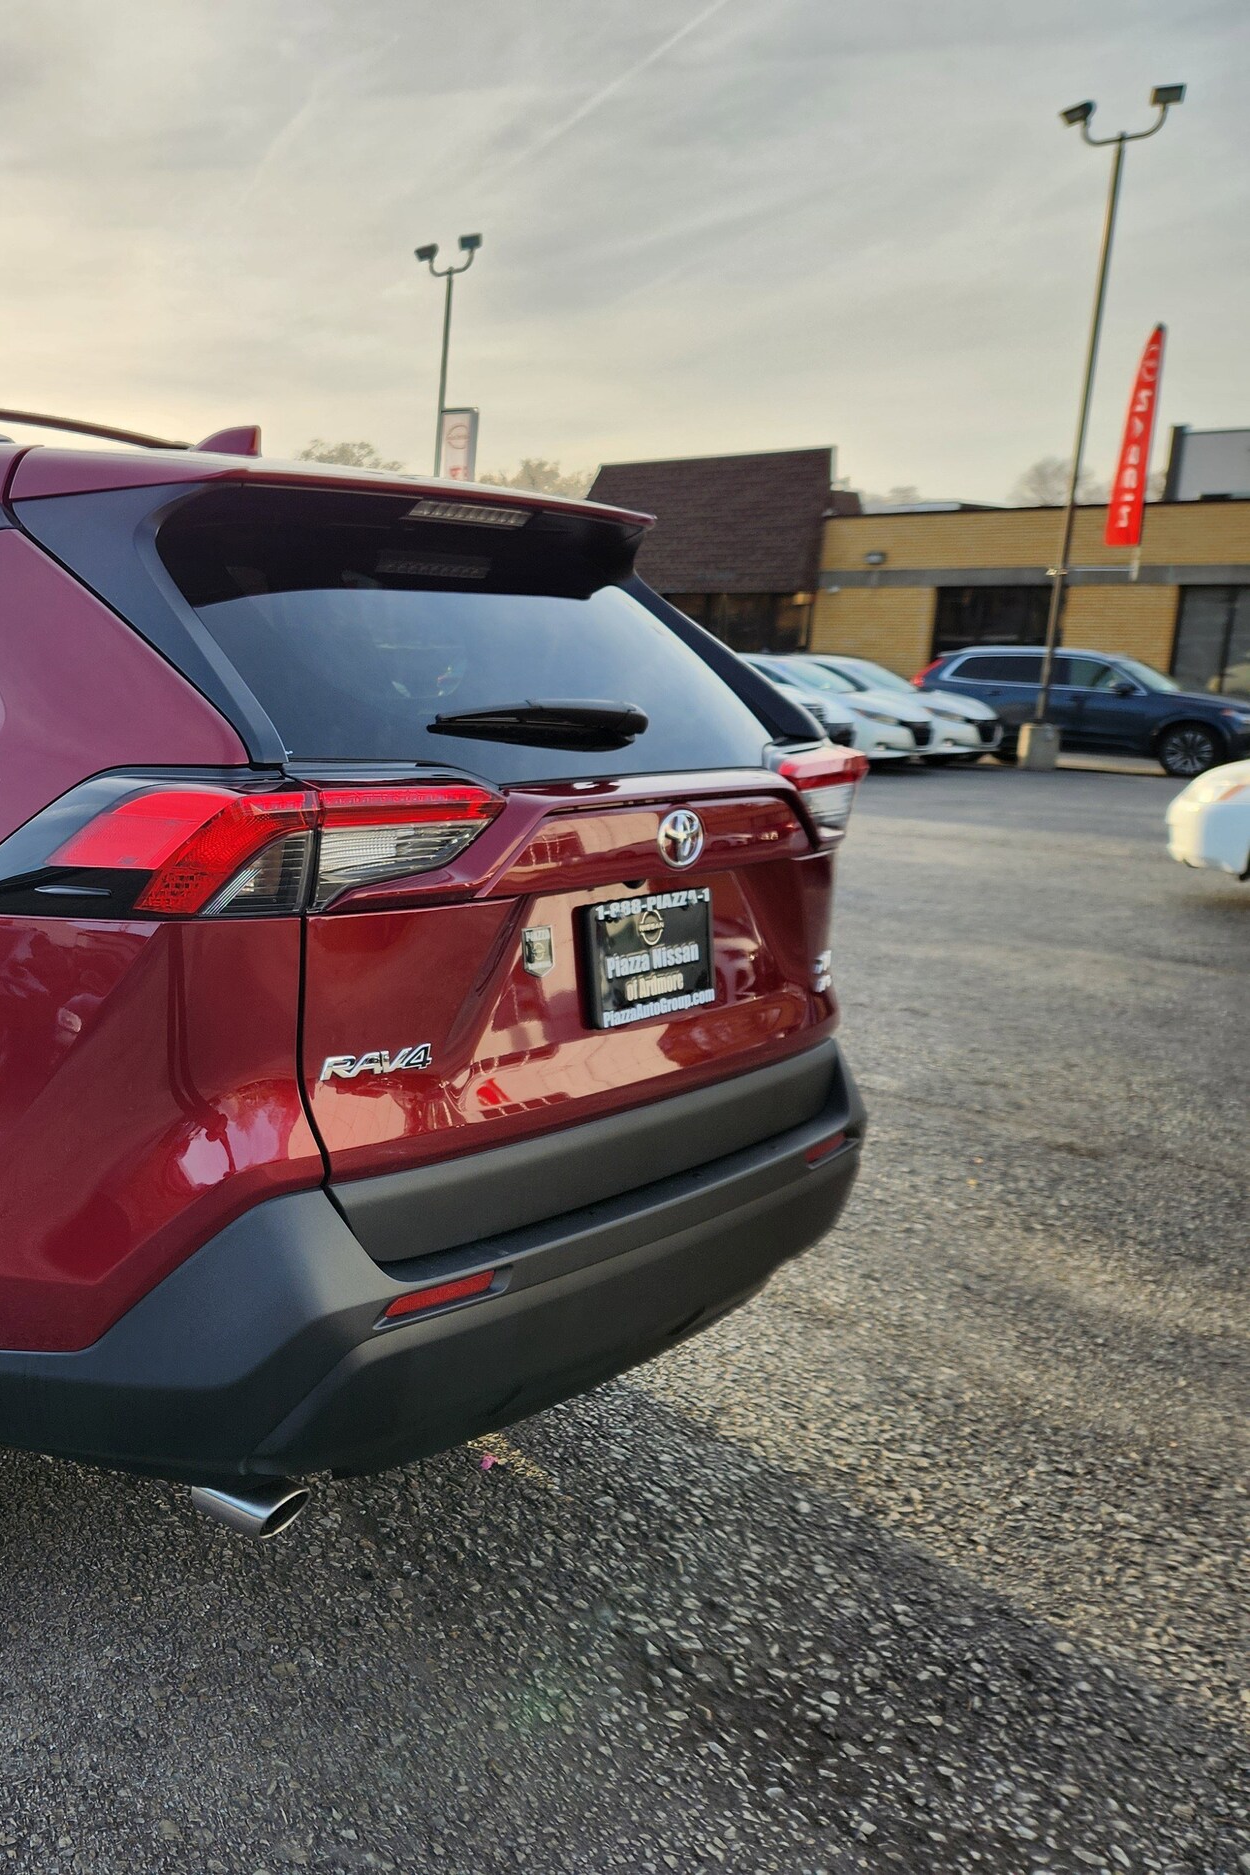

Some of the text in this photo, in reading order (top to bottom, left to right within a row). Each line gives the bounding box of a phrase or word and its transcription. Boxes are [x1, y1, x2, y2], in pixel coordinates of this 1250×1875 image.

[606, 943, 699, 979] Piazza Nissan
[626, 971, 684, 1001] of Ardmore
[603, 988, 715, 1028] PiazzaAutoGroup.com
[319, 1043, 432, 1081] RAV4
